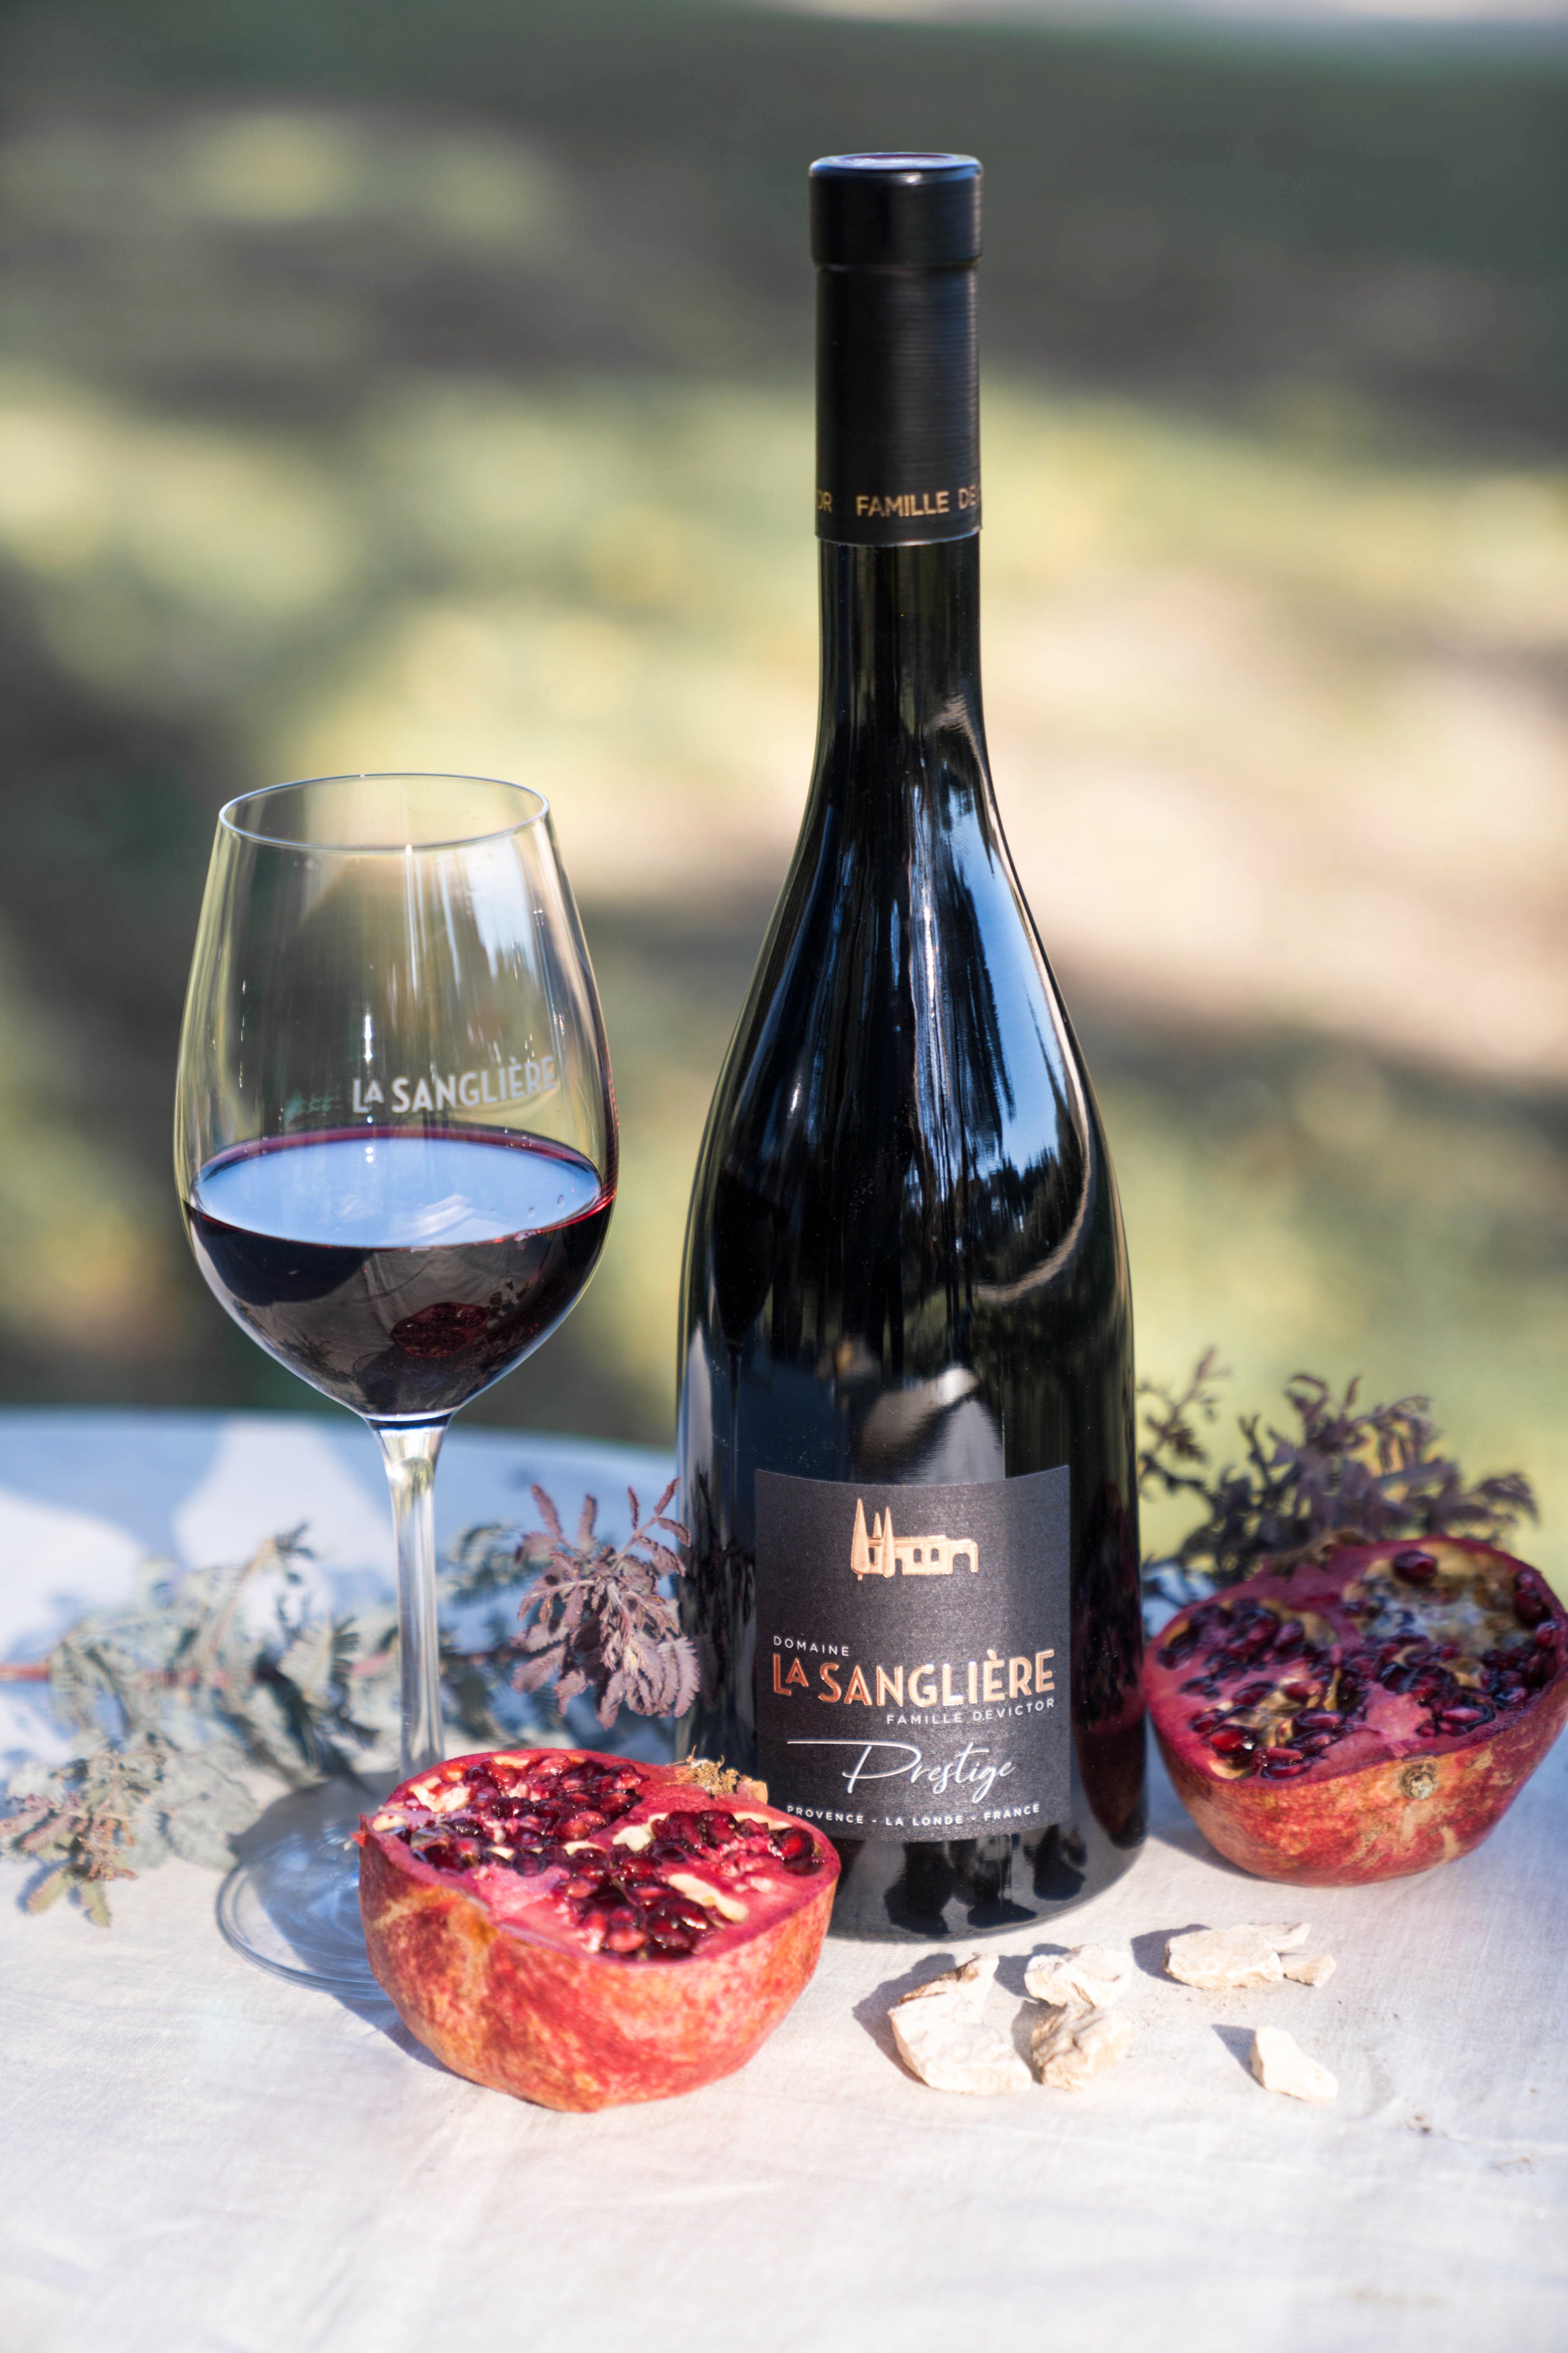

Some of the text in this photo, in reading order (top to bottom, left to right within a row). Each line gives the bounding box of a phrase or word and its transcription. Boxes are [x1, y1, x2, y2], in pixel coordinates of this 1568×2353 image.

[856, 491, 950, 516] FAMILLE
[353, 1055, 556, 1113] LA SANGLIÈRE
[773, 1635, 849, 1657] DOMAINE
[773, 1649, 1055, 1707] LA SANGLIÈRE
[887, 1698, 1055, 1725] FAMILLE DEVICTOR
[787, 1738, 1015, 1803] Prestige
[787, 1805, 864, 1824] PROVENCE
[885, 1816, 904, 1826] LA
[912, 1814, 963, 1826] LONDE
[983, 1803, 1040, 1822] FRANCE
